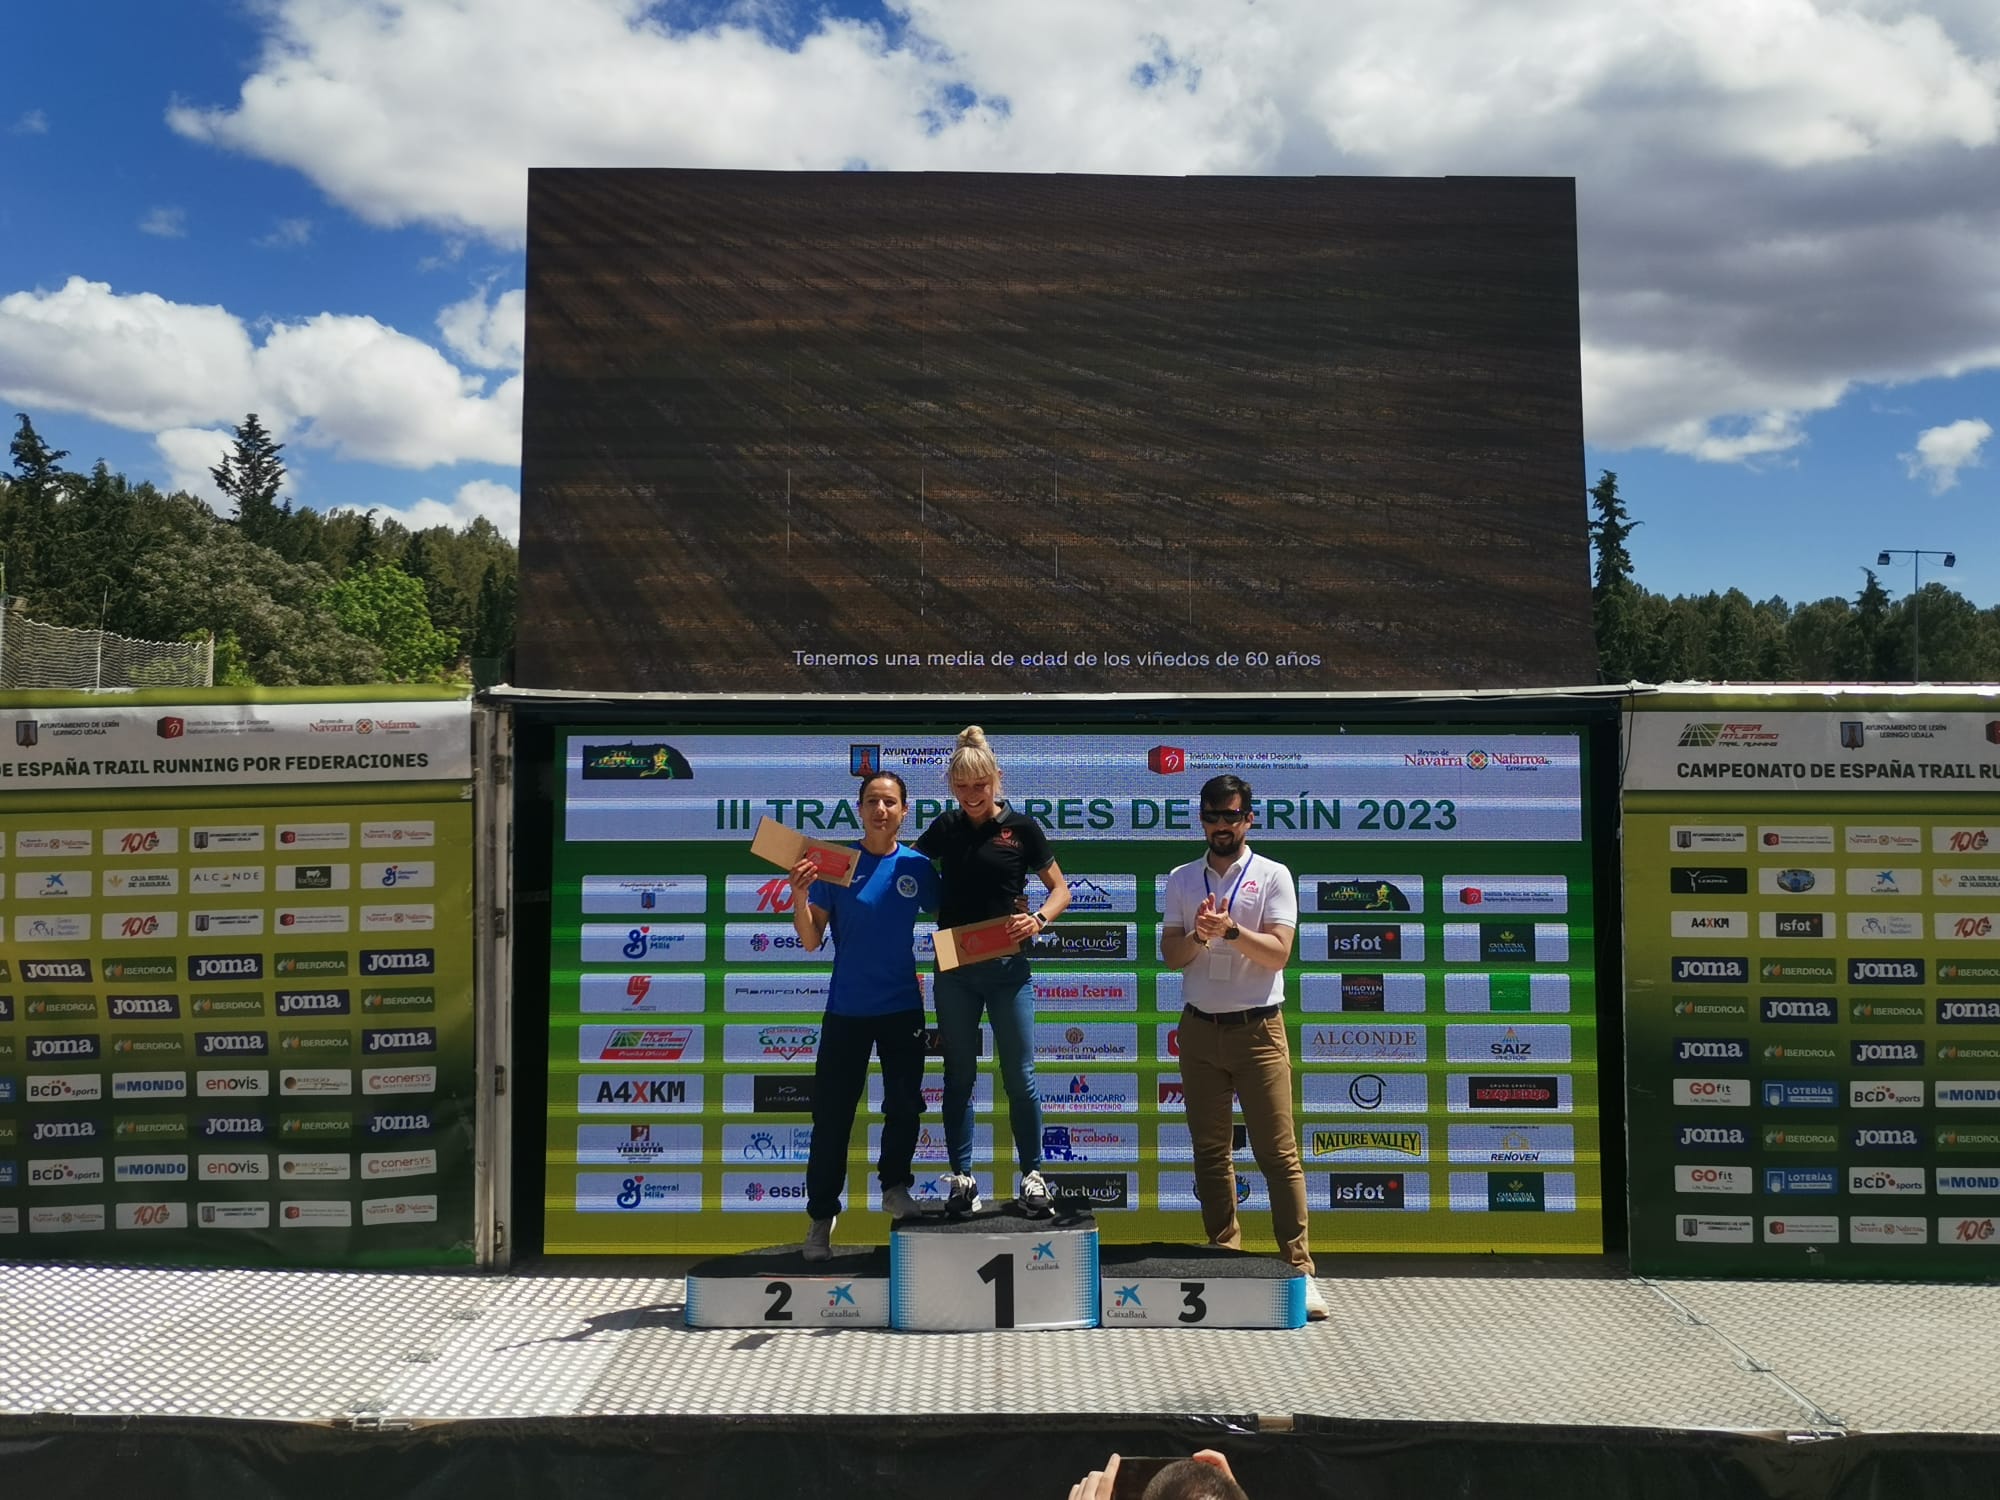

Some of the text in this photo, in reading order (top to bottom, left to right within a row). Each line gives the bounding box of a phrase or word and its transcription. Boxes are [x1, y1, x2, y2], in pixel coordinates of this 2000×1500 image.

[792, 650, 1321, 666] Tenemos una media de edad de los viñedos de 60 años
[309, 722, 354, 733] Navarra
[18, 758, 90, 777] ESPAÑA
[94, 759, 149, 775] TRAIL
[154, 758, 239, 774] RUNNING
[243, 756, 280, 772] POR
[285, 753, 428, 771] FEDERACIONES
[1404, 754, 1463, 767] Navarra
[1677, 763, 1806, 779] CAMPEONATO
[1811, 763, 1836, 779] DE
[1840, 759, 1915, 779] ESPAÑA
[1919, 763, 1976, 779] TRAIL
[717, 799, 750, 830] III
[766, 799, 865, 830] TRA
[916, 799, 1114, 830] PRES
[1131, 799, 1191, 830] DE
[1357, 799, 1457, 831] 2023
[1691, 917, 1729, 928] A4XKM
[1780, 919, 1811, 931] isfot
[1062, 936, 1121, 949] lacturale
[1334, 934, 1382, 951] isfot
[124, 966, 173, 975] IBERDROLA
[296, 961, 346, 970] IBERDROLA
[1782, 967, 1833, 976] IBERDROLA
[212, 1001, 261, 1010] IBERDROLA
[383, 996, 432, 1005] IBERDROLA
[46, 1003, 96, 1012] IBERDROLA
[1694, 1005, 1745, 1014] IBERDROLA
[1873, 1007, 1923, 1016] IBERDROLA
[301, 1038, 349, 1047] IBERDROLA
[759, 1035, 818, 1046] GALO
[1312, 1031, 1417, 1046] ALCONDE
[133, 1041, 181, 1050] IBERDROLA
[1491, 1043, 1531, 1054] SAIZ
[1784, 1049, 1835, 1057] IBERDROLA
[31, 1085, 98, 1097] BCD sports
[127, 1080, 184, 1092] MONDO
[1787, 1087, 1833, 1095] LOTERÍAS
[597, 1081, 685, 1103] A4XKM
[1854, 1091, 1920, 1104] BCD sports
[1040, 1094, 1126, 1103] LTAMIRACHOCARRO
[136, 1123, 184, 1132] IBERDROLA
[302, 1121, 349, 1130] IBERDROLA
[1071, 1133, 1119, 1143] la cabaña
[1316, 1133, 1418, 1153] NATURE VALLEY
[1786, 1135, 1835, 1144] IBERDROLA
[1491, 1151, 1540, 1161] RENOVEN
[129, 1163, 186, 1175] MONDO
[32, 1169, 100, 1181] BCD sports
[1788, 1172, 1833, 1182] LOTERÍAS
[1853, 1177, 1922, 1191] BCD sports
[1951, 1177, 2000, 1188] MOND
[769, 1182, 806, 1198] essi
[1337, 1182, 1384, 1199] isfot
[1026, 1263, 1059, 1271] CaixaBank
[977, 1253, 1014, 1328] 1
[764, 1281, 792, 1321] 2
[1178, 1282, 1207, 1323] 3
[820, 1309, 861, 1319] CaixaBank
[1107, 1310, 1147, 1319] CaixaBank
